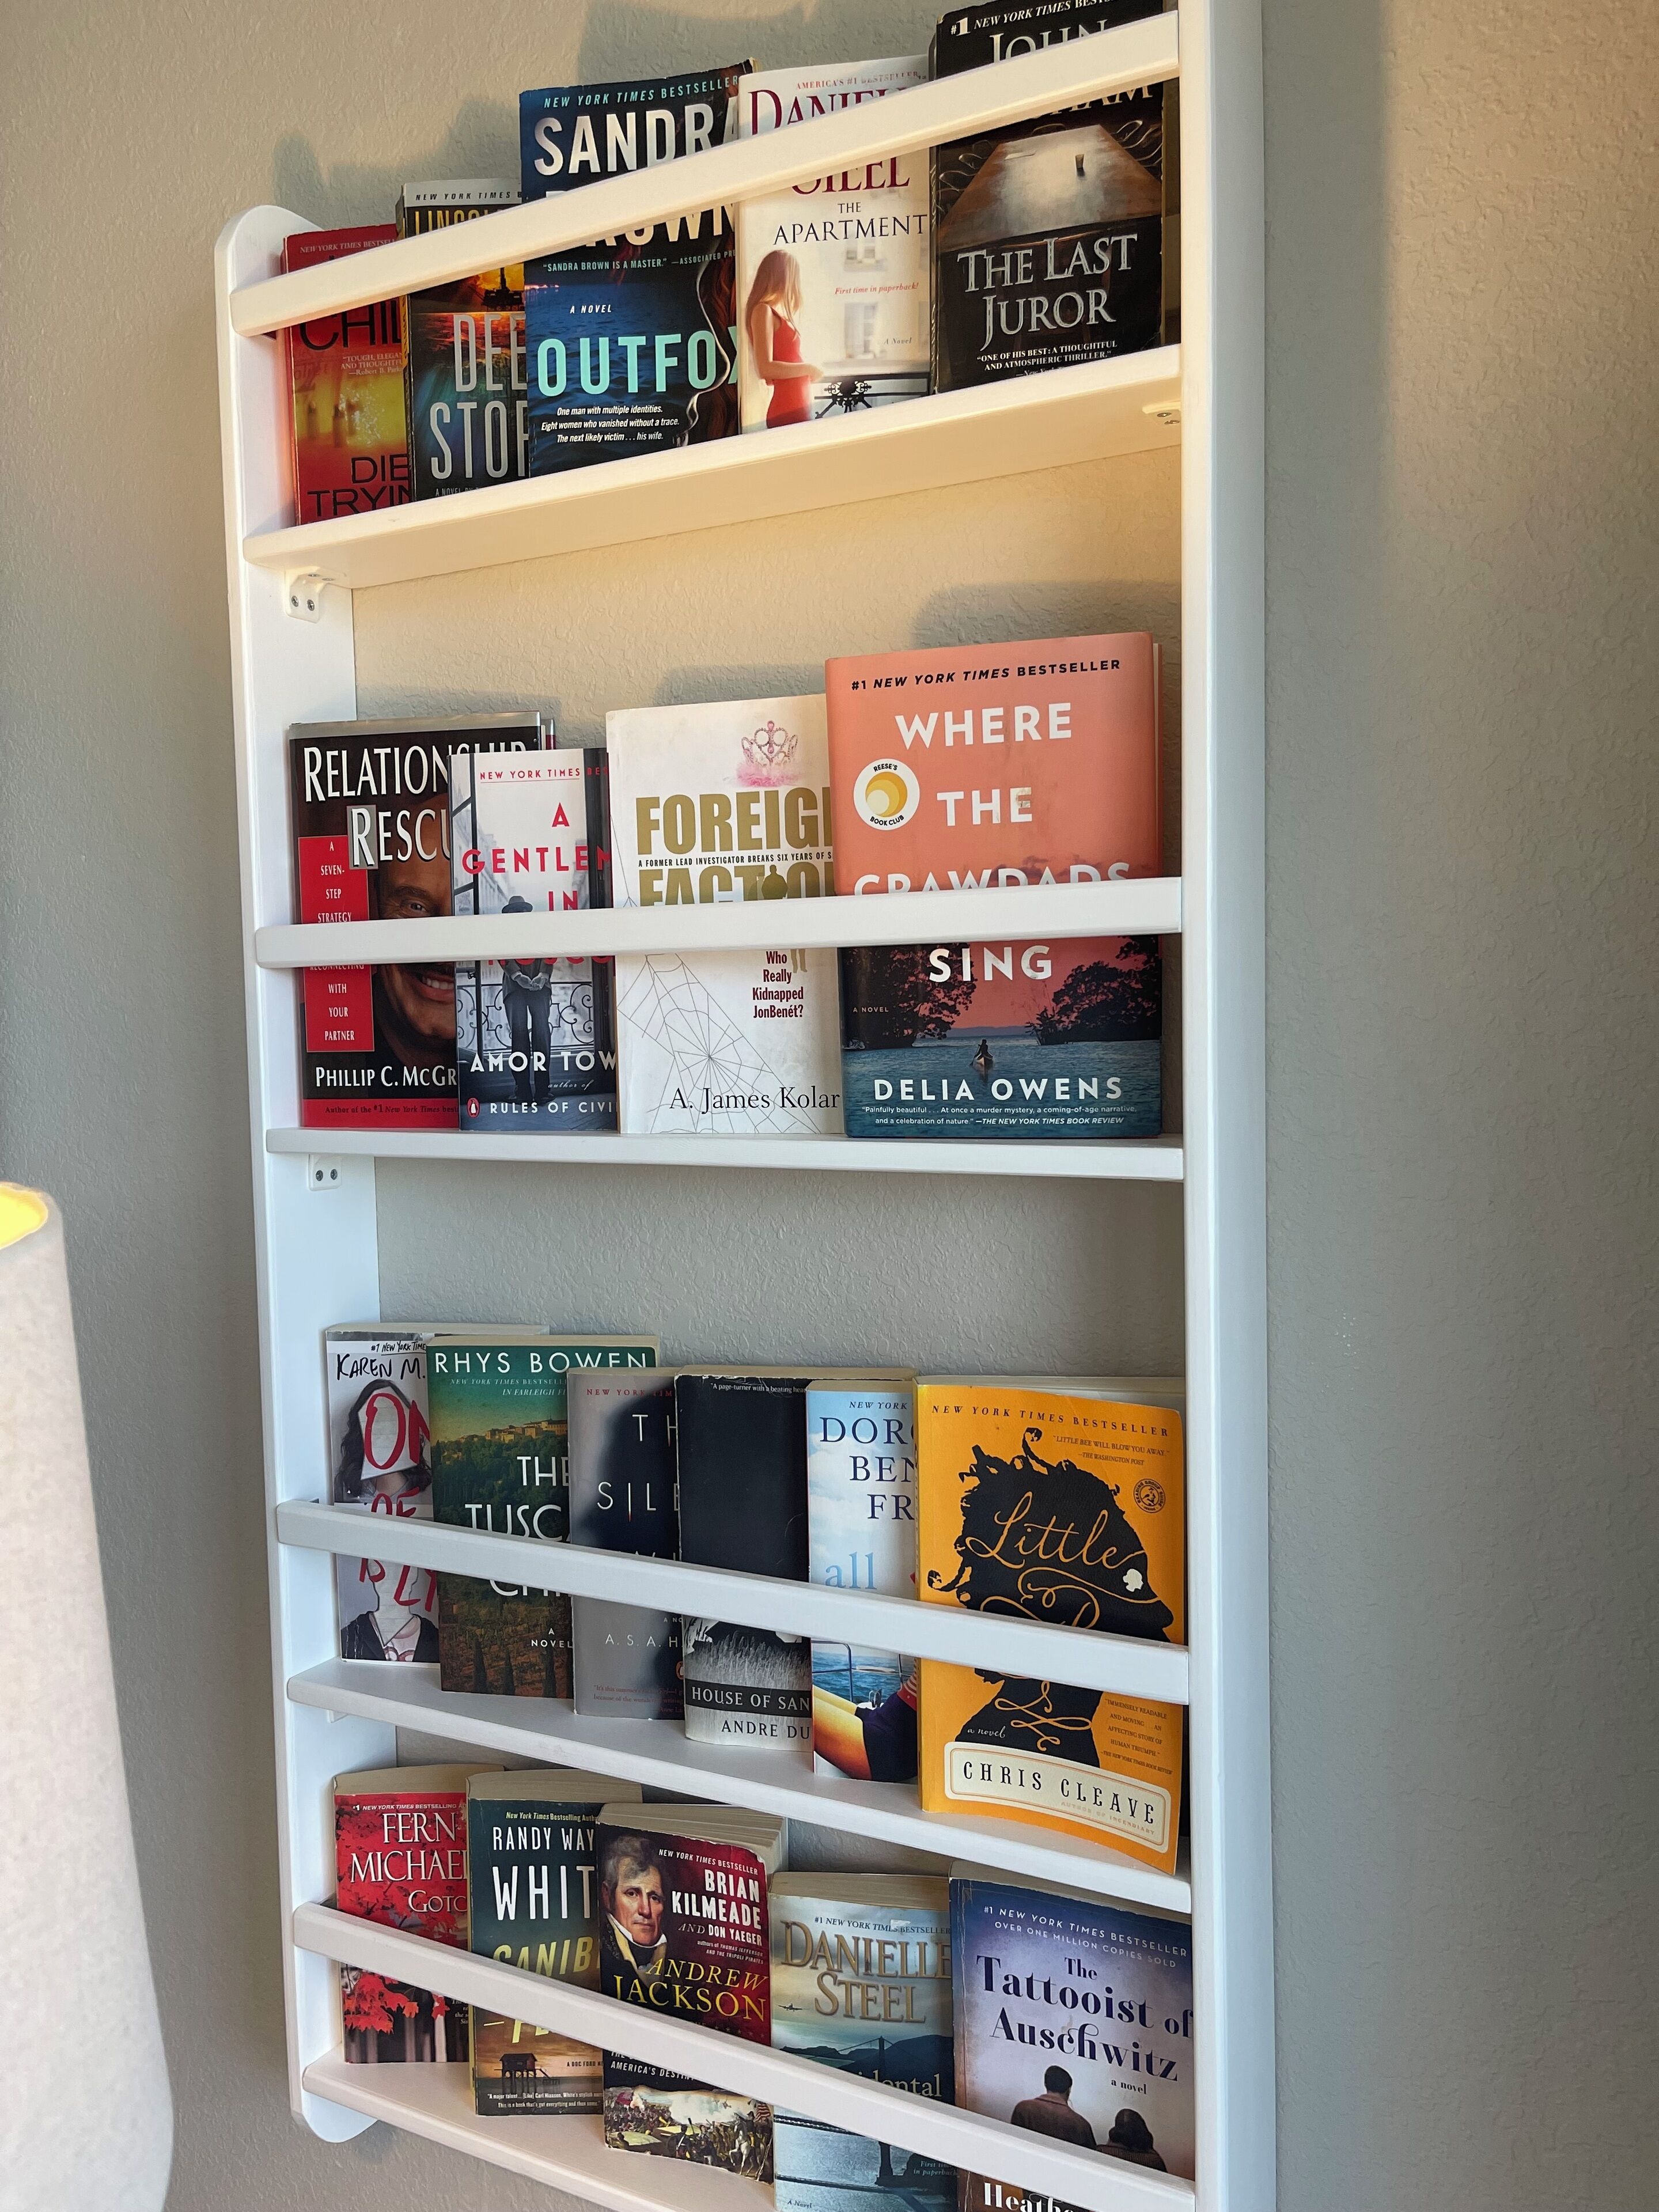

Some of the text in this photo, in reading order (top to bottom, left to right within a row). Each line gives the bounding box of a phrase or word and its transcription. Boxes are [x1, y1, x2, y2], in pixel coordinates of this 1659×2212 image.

[950, 2, 1071, 36] #1 NEW YORK TIMES
[544, 75, 738, 108] NEW YORK TIMES BESTSELLER
[838, 202, 861, 213] THE
[773, 214, 927, 245] APARTMENT
[581, 261, 609, 270] BROWN
[613, 261, 620, 269] IS
[623, 260, 628, 268] A
[957, 233, 1138, 292] THE LAST
[570, 305, 612, 313] A NOVEL
[980, 289, 1117, 351] JUROR
[977, 354, 998, 362] “ONE
[1000, 352, 1010, 360] OF
[1012, 351, 1026, 359] HIS
[1028, 348, 1051, 357] BEST:
[1059, 340, 1117, 354] THOUGHTFUL
[984, 361, 1002, 370] AND
[1003, 355, 1062, 368] ATMOSPHERIC
[541, 421, 558, 430] Eight
[599, 419, 627, 427] vanished
[629, 418, 654, 426] without
[851, 660, 1120, 690] #1 NEW YORK TIMES BESTSELLER
[895, 702, 1072, 750] WHERE
[510, 770, 541, 779] YORK
[548, 768, 580, 777] TIMES
[873, 763, 898, 772] REESE'S
[552, 802, 570, 827] A
[937, 786, 1032, 826] THE
[870, 815, 904, 826] BOOK CLUB
[329, 841, 334, 851] A
[321, 865, 344, 876] SEVEN-
[646, 859, 672, 867] FORMER
[696, 856, 744, 865] INVESTIGATOR
[748, 854, 774, 863] BREAKS
[777, 854, 788, 862] SIX
[791, 853, 813, 861] YEARS
[325, 889, 342, 899] STEP
[548, 891, 578, 911] IN
[318, 912, 351, 923] STRATEGY
[766, 951, 787, 964] Who
[929, 945, 1052, 982] SING
[763, 969, 791, 984] Really
[328, 983, 347, 994] WITH
[752, 987, 803, 1002] Kidnapped
[328, 1007, 348, 1017] YOUR
[753, 1004, 803, 1018] JonBenét?
[325, 1031, 355, 1041] PARTNER
[471, 1051, 547, 1072] AMOR
[316, 1066, 398, 1086] PHILLIP C.
[669, 1086, 840, 1114] A. James Kolar
[874, 1077, 1122, 1101] DELIA OWENS
[490, 1103, 569, 1114] RULES OF
[337, 1354, 425, 1380] KAREN M.
[435, 1352, 646, 1373] RHYS BOWEN
[932, 1406, 1168, 1437] NEW YORK TIMES BESTSELLER
[965, 1491, 1146, 1569] Little
[825, 1551, 877, 1589] all
[532, 1639, 573, 1648] NOVEL
[692, 1687, 743, 1705] HOUSE
[751, 1694, 770, 1707] OF
[722, 1720, 777, 1737] ANDRE
[978, 1726, 1006, 1738] novel
[964, 1762, 1154, 1824] CHRIS CLEAVE
[382, 1812, 459, 1843] FERN
[493, 1827, 593, 1851] RANDY WAY
[676, 1851, 693, 1861] YORK
[696, 1855, 716, 1865] TIMES
[718, 1859, 758, 1876] BESTSELLER
[492, 1865, 595, 1921] WHIT
[704, 1869, 759, 1903] BRIAN
[672, 1891, 762, 1930] KILMEADE
[679, 1923, 762, 1946] AND DON YAEGER
[825, 1918, 844, 1926] NEW
[847, 1921, 870, 1930] YORK
[900, 1926, 950, 1934] BESTSELLER
[984, 1906, 1187, 1957] #1 NEW YORK TIMES BESTSELLER
[995, 1922, 1176, 1968] OVER ONE MILLION COPIES SOLD
[646, 1958, 768, 1991] ANDREW
[1065, 1957, 1097, 1980] The
[613, 1975, 767, 2022] JACKSON
[815, 1971, 925, 2022] STEEL
[977, 1956, 1193, 2037] Tattooist of
[989, 2007, 1178, 2082] Auschwitz
[1121, 2082, 1147, 2094] novel
